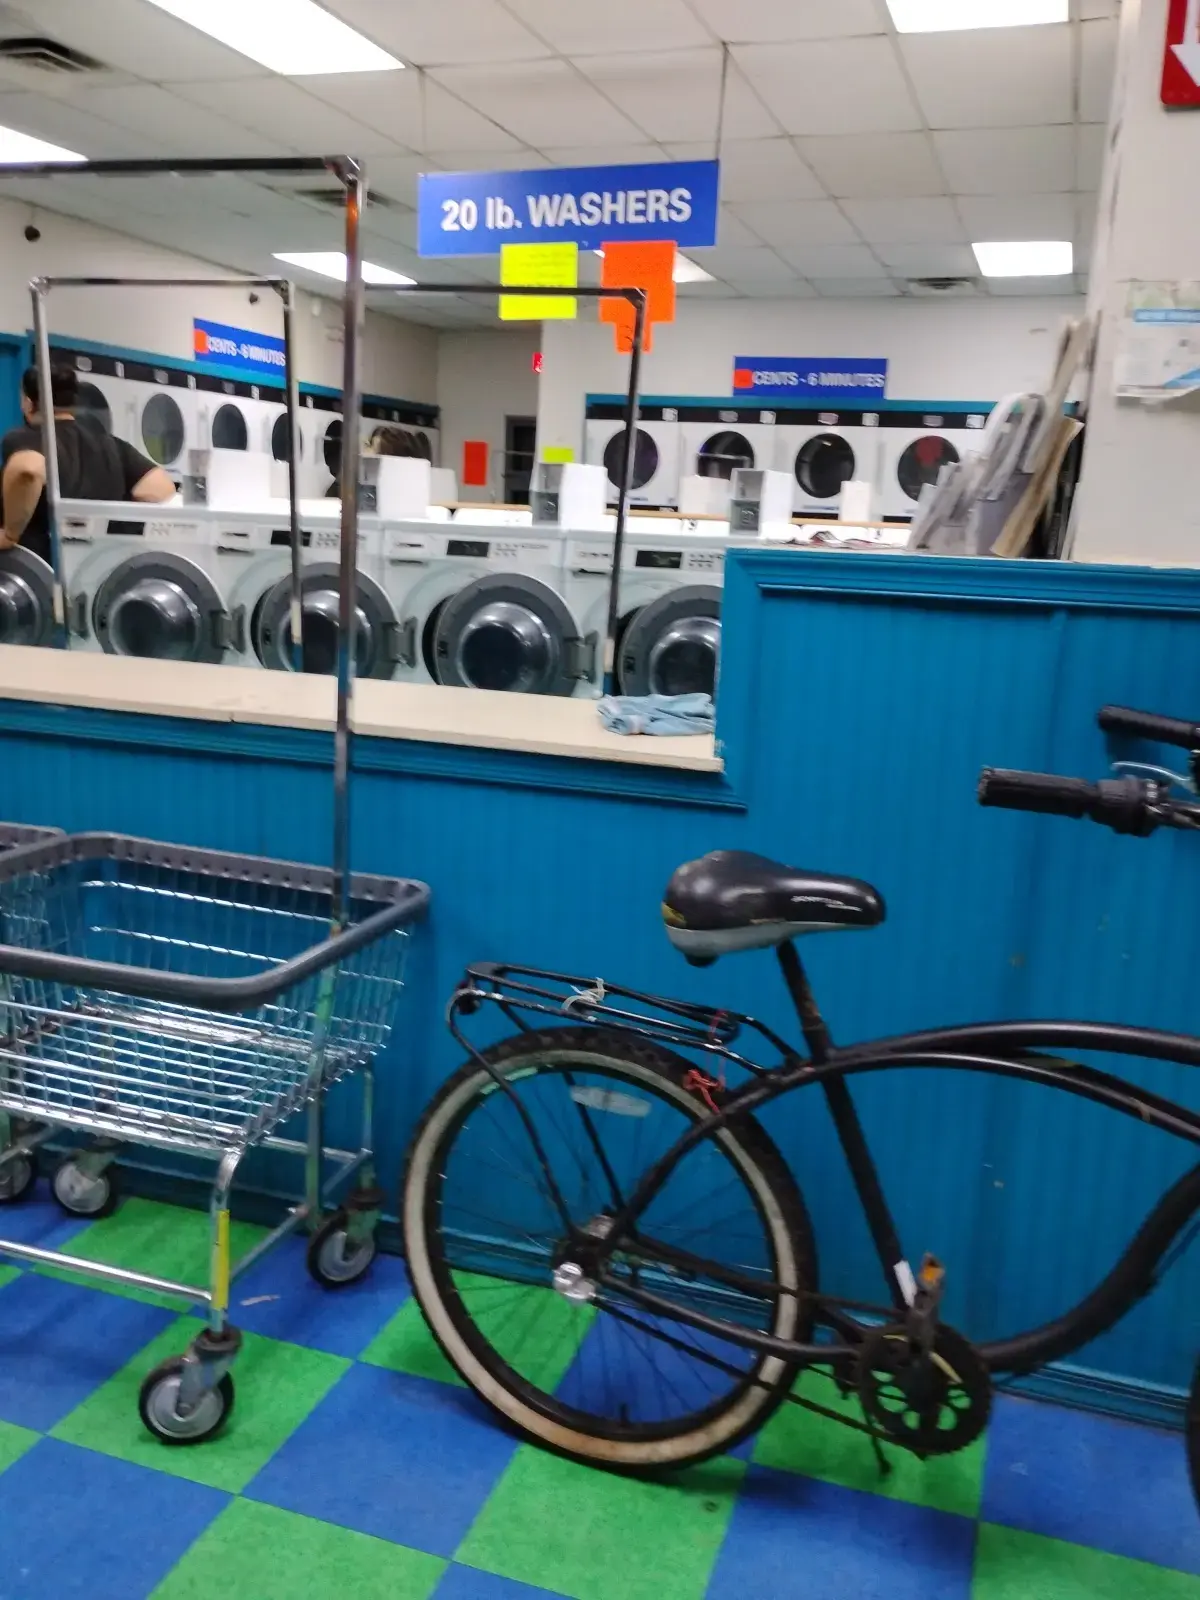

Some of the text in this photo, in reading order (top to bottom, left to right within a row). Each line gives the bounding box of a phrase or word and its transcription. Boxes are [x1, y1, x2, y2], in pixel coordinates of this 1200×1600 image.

[441, 188, 692, 231] 20 lb. WASHERS
[753, 370, 799, 386] CENTS
[807, 372, 818, 387] 6
[819, 372, 885, 388] MINUTES
